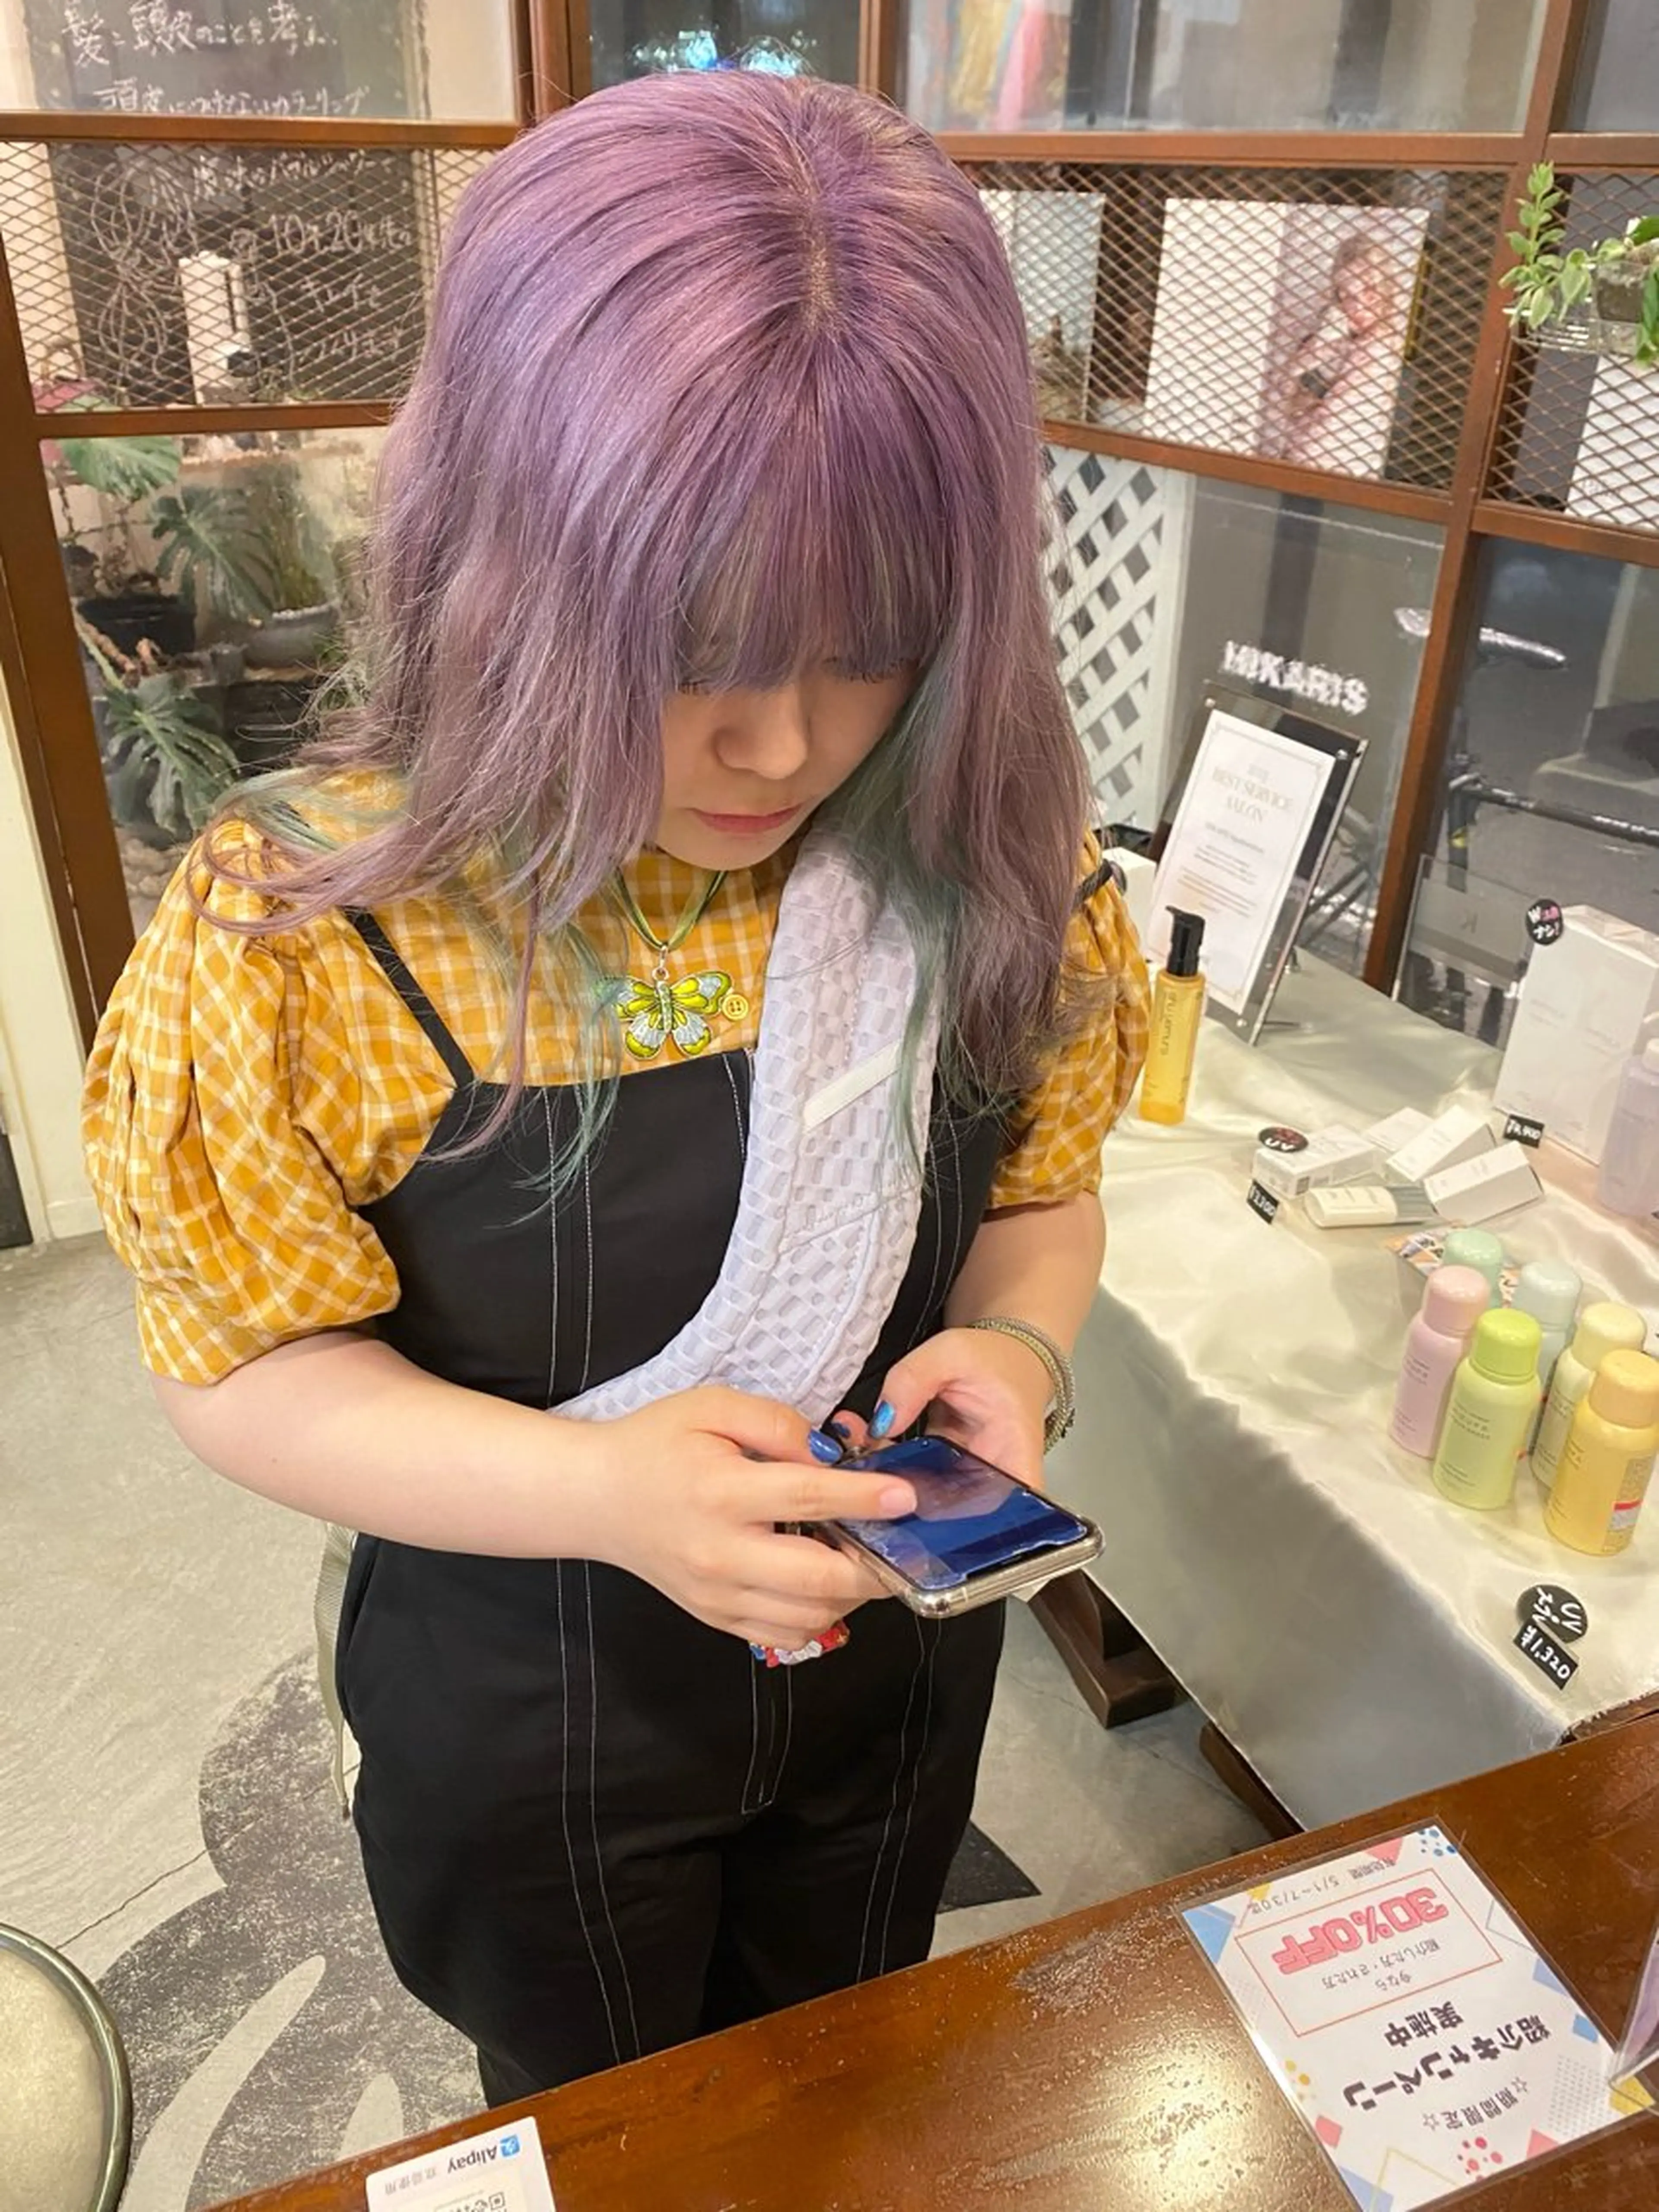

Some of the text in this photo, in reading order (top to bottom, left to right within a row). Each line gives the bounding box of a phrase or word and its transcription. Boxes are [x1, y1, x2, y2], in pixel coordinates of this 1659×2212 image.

[1520, 1624, 1570, 1679] ¥1,320
[1271, 1887, 1449, 1975] 30%OFF
[1375, 1970, 1411, 1991] 今なら
[1384, 2001, 1464, 2047] 実施中
[1343, 2015, 1551, 2111] 紹介キャンペーン
[447, 2145, 497, 2174] Alipay
